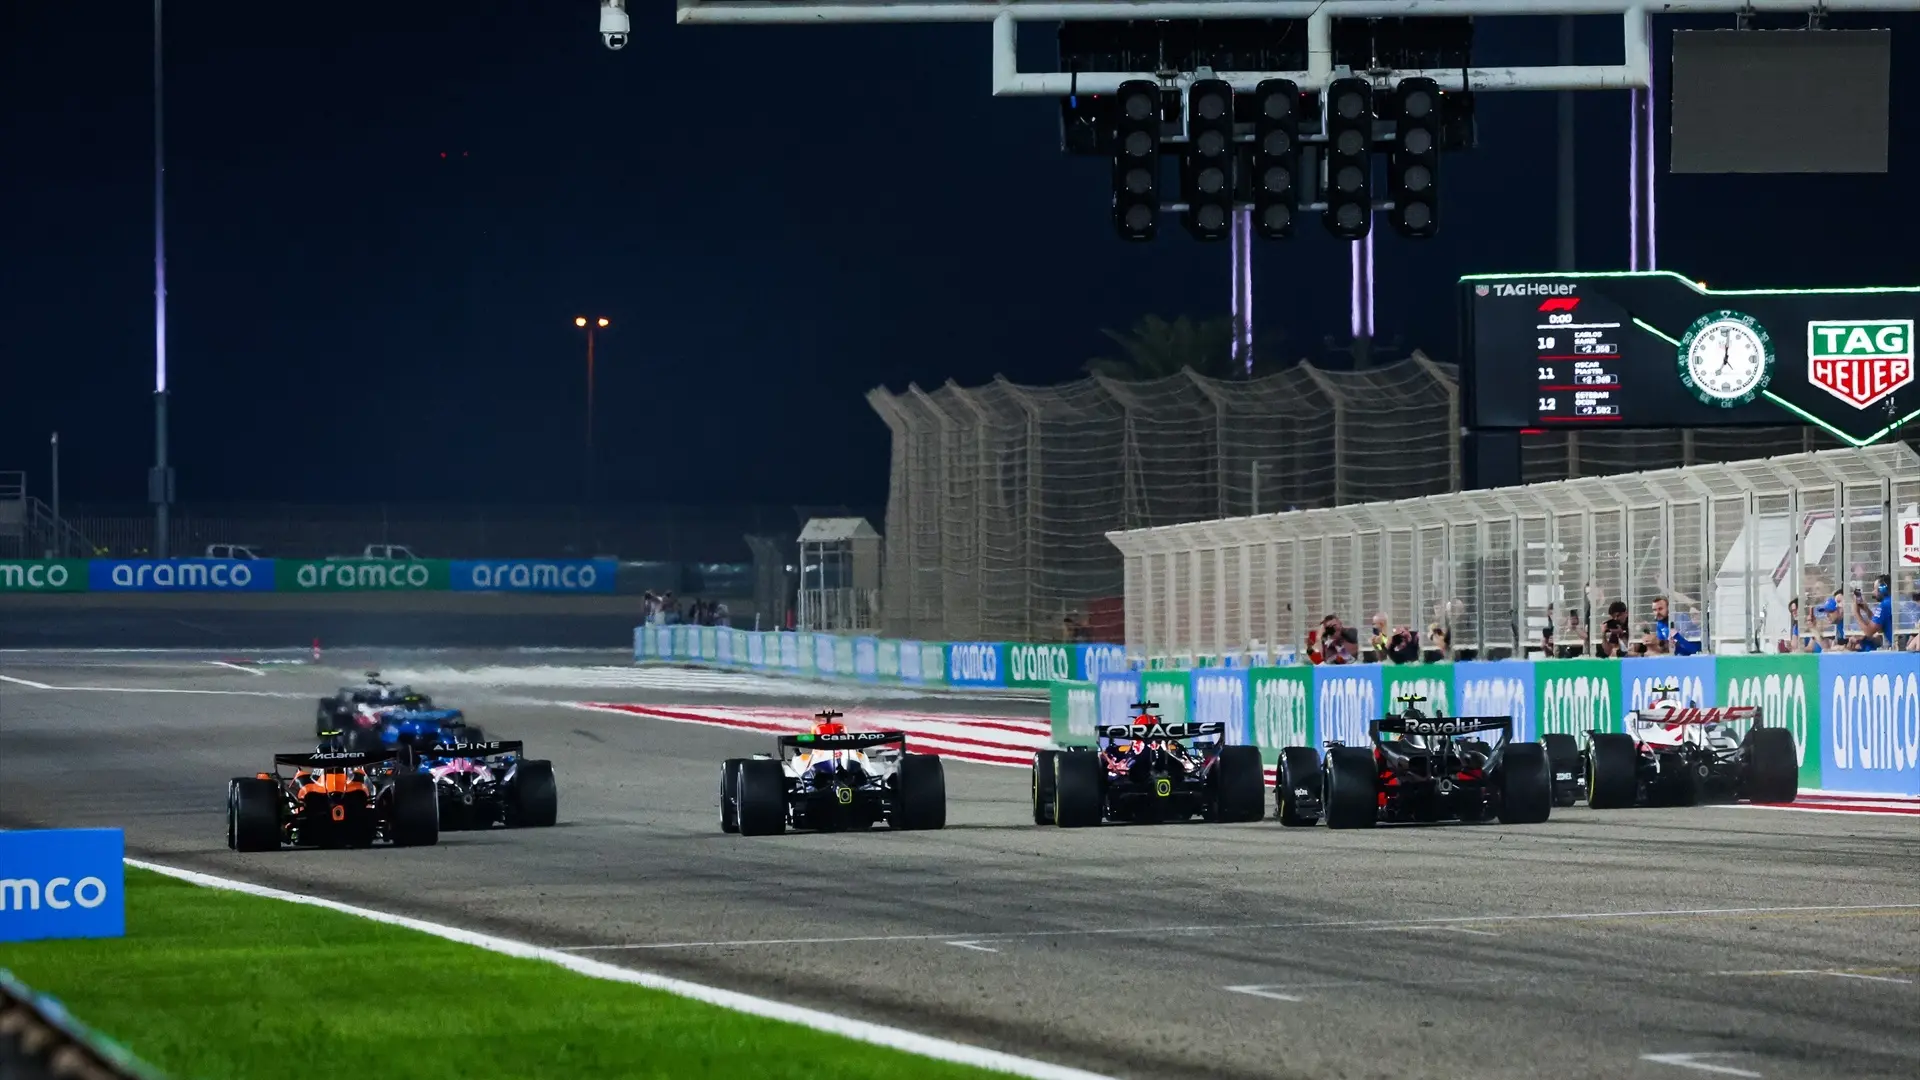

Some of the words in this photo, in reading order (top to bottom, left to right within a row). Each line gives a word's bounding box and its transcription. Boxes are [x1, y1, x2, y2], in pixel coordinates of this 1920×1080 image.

[1548, 314, 1573, 324] 0:00
[1537, 337, 1556, 350] 10
[1817, 327, 1904, 353] TAG
[1538, 367, 1556, 380] 11
[1815, 360, 1906, 402] HEUER
[1538, 398, 1556, 411] 12
[112, 564, 251, 587] aramco
[296, 564, 429, 587] aramco
[472, 564, 597, 587] aramco
[951, 645, 997, 681] aramco
[1011, 646, 1069, 682] aramco
[1106, 722, 1218, 738] ORACLE
[1405, 717, 1482, 734] Revolut
[1833, 672, 1920, 771] aramco
[309, 751, 365, 760] McLaren
[433, 741, 500, 751] ALPINE
[0, 876, 107, 910] mco
